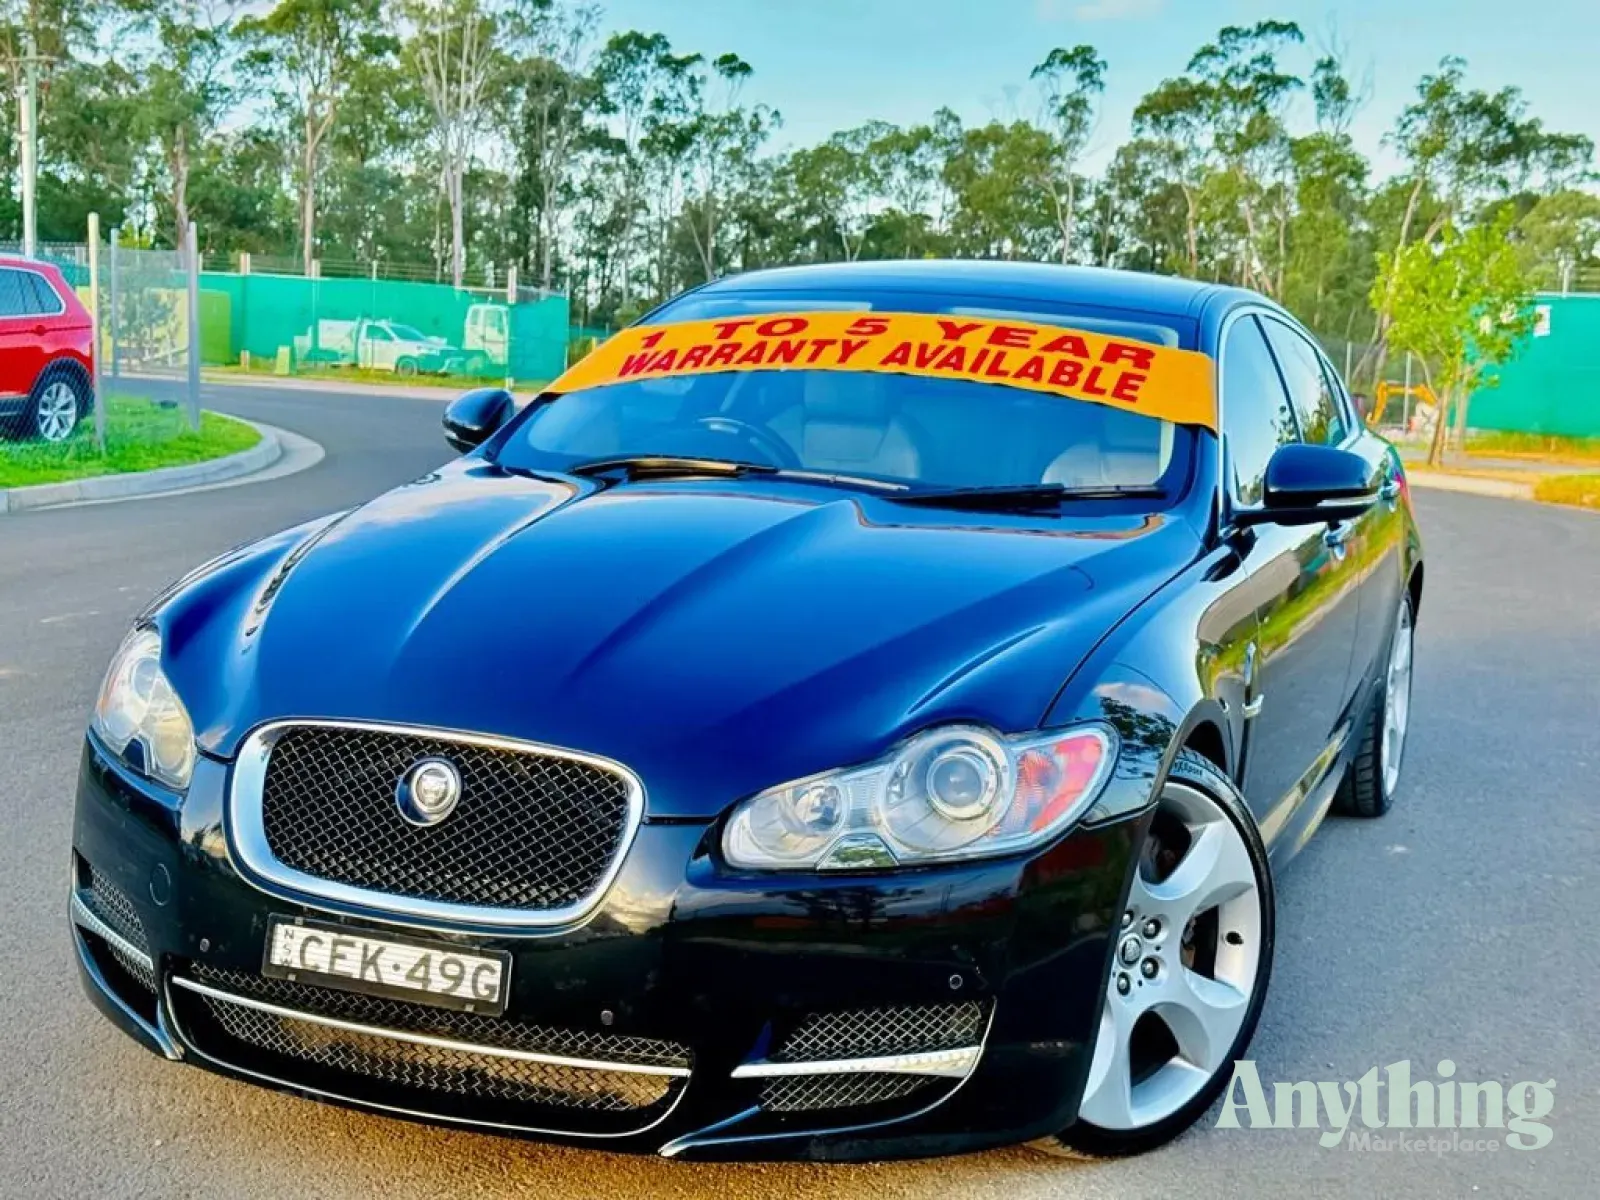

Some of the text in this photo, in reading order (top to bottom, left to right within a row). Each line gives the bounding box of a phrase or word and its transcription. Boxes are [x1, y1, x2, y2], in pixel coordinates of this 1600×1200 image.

[618, 339, 1147, 402] WARRANTY AVAILABLE
[641, 318, 1155, 369] 1 TO 5 YEAR
